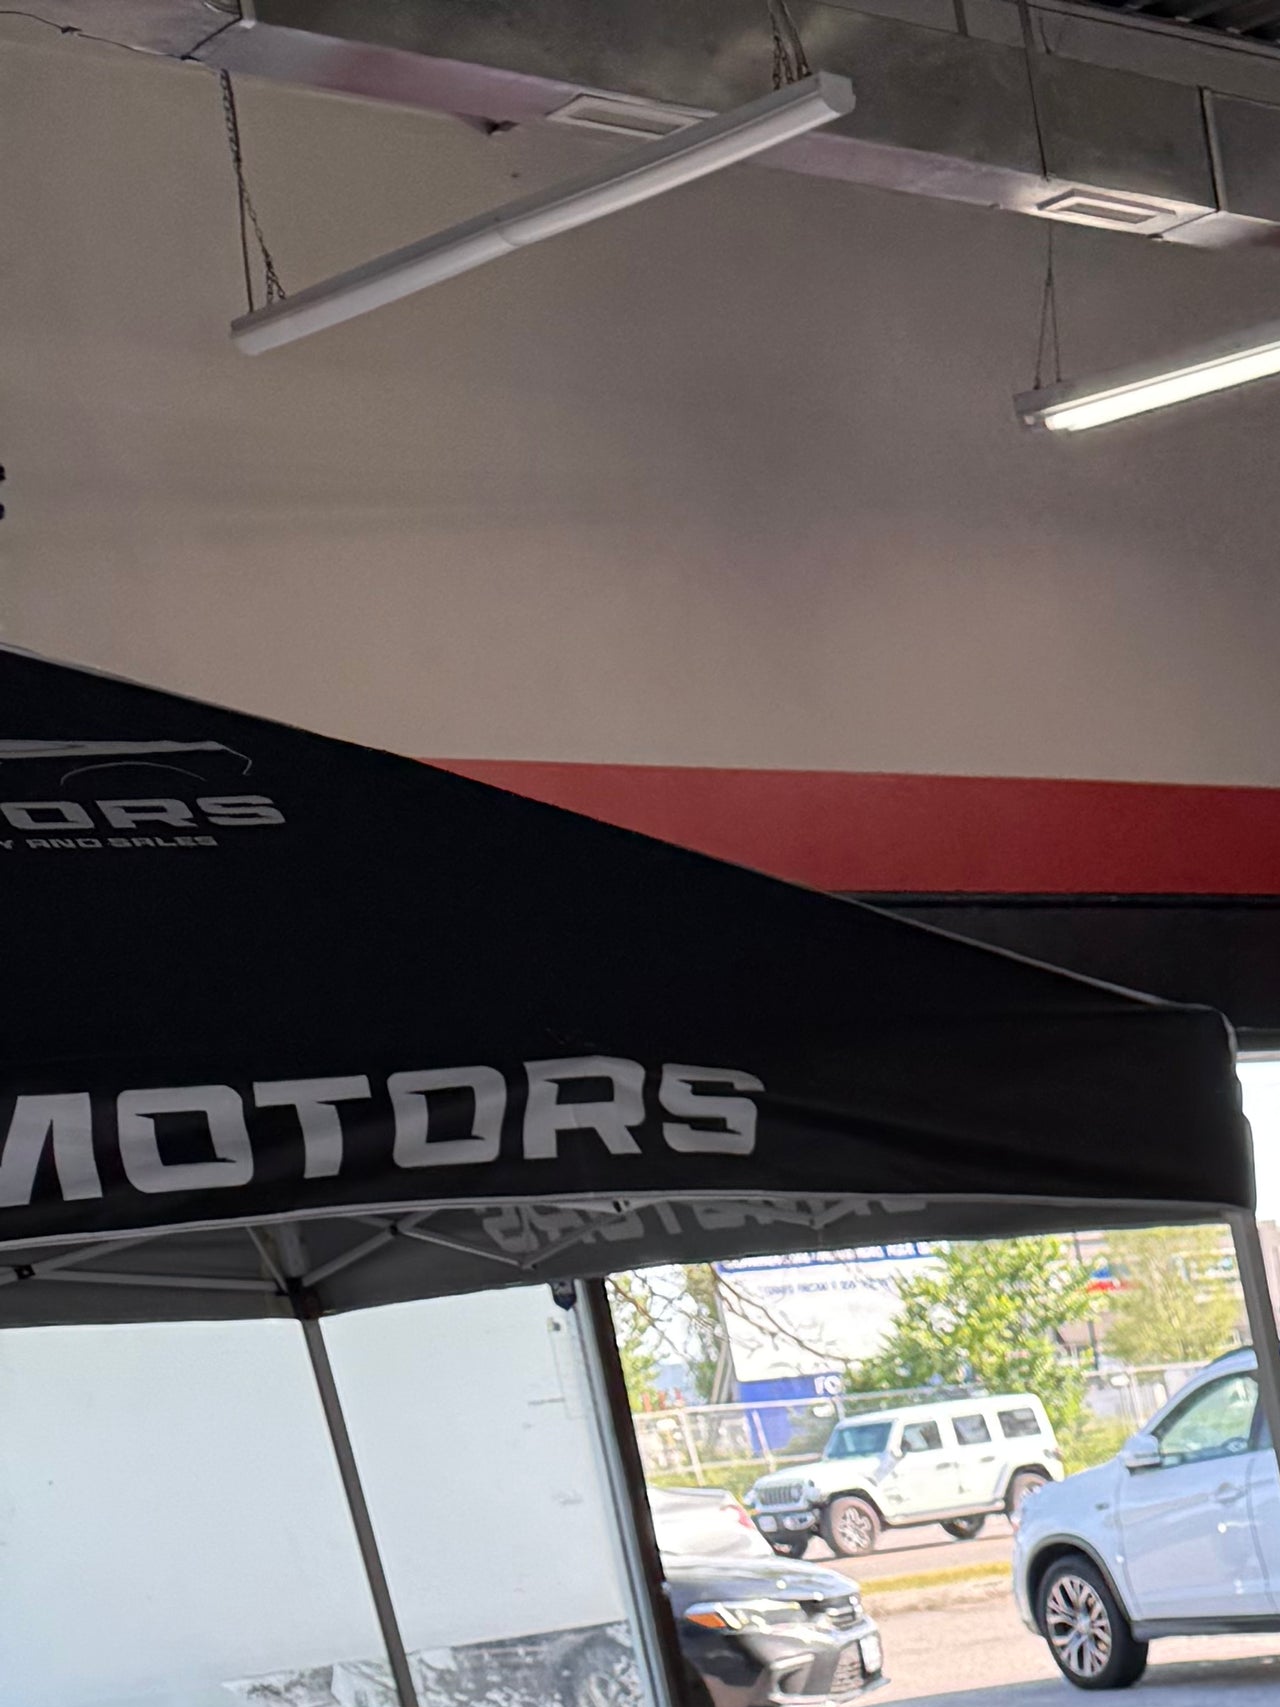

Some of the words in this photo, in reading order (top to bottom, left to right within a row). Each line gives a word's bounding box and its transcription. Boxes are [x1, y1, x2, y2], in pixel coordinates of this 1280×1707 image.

[26, 838, 102, 849] AND
[107, 836, 218, 847] SALES
[0, 1056, 765, 1205] MOTORS
